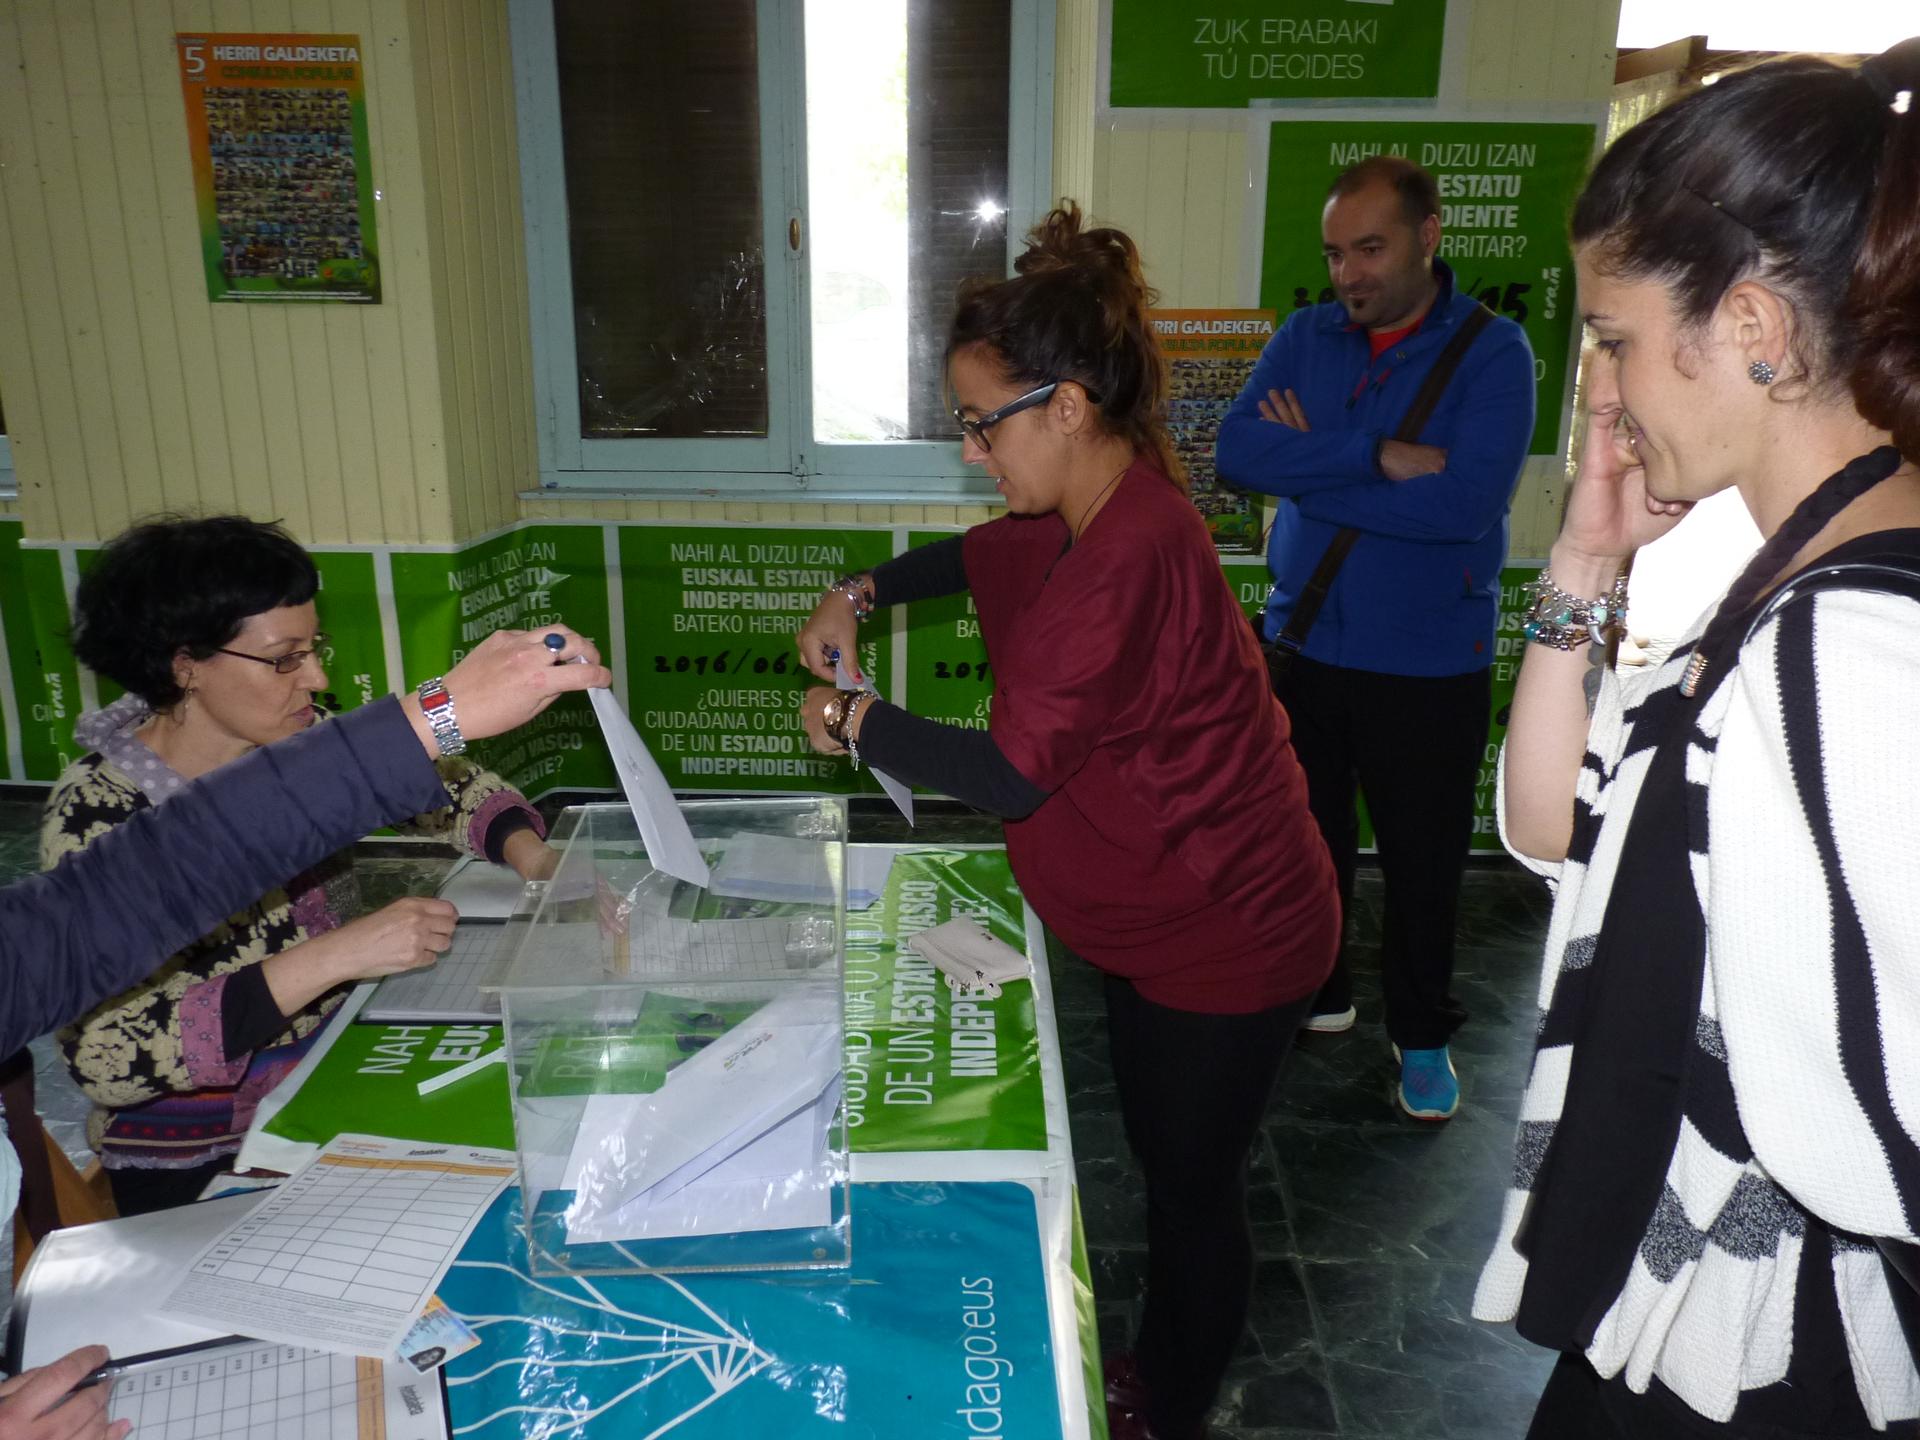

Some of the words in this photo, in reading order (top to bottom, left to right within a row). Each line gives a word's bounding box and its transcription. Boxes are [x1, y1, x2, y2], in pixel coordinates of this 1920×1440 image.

[1193, 18, 1250, 44] ZUK
[1261, 18, 1378, 44] ERABAKI
[186, 46, 206, 73] 5
[212, 46, 260, 61] HERRI
[263, 46, 359, 62] GALDEKETA
[1202, 47, 1238, 80] TÚ
[1249, 53, 1365, 80] DECIDES
[1421, 144, 1480, 167] DUZU
[1486, 144, 1536, 168] IZAN
[1436, 174, 1521, 198] ESTATU
[1440, 205, 1519, 228] DIENTE
[1439, 235, 1527, 258] RRITAR?
[1152, 320, 1179, 335] RRI
[1181, 320, 1272, 335] GALDEKETA
[671, 543, 714, 563] NAHI
[719, 544, 742, 563] AL
[749, 545, 797, 564] DUZU
[804, 546, 844, 565] IZAN
[682, 567, 758, 586] EUSKAL
[764, 569, 835, 587] ESTATU
[682, 590, 823, 610] INDEPENDIENT
[674, 614, 743, 633] BATEKO
[750, 615, 811, 634] HERRI
[697, 689, 783, 711] ¿QUIERES
[645, 711, 749, 730] CIUDADANA
[753, 712, 766, 731] O
[661, 733, 685, 752] DE
[690, 734, 716, 752] UN
[721, 735, 794, 754] ESTADO
[681, 756, 838, 779] INDEPENDIENTE?
[896, 880, 938, 937] VASCO
[357, 1025, 433, 1075] NAH
[887, 1029, 935, 1063] UN
[884, 1072, 934, 1105] DE
[956, 1277, 1014, 1440] dago.eus
